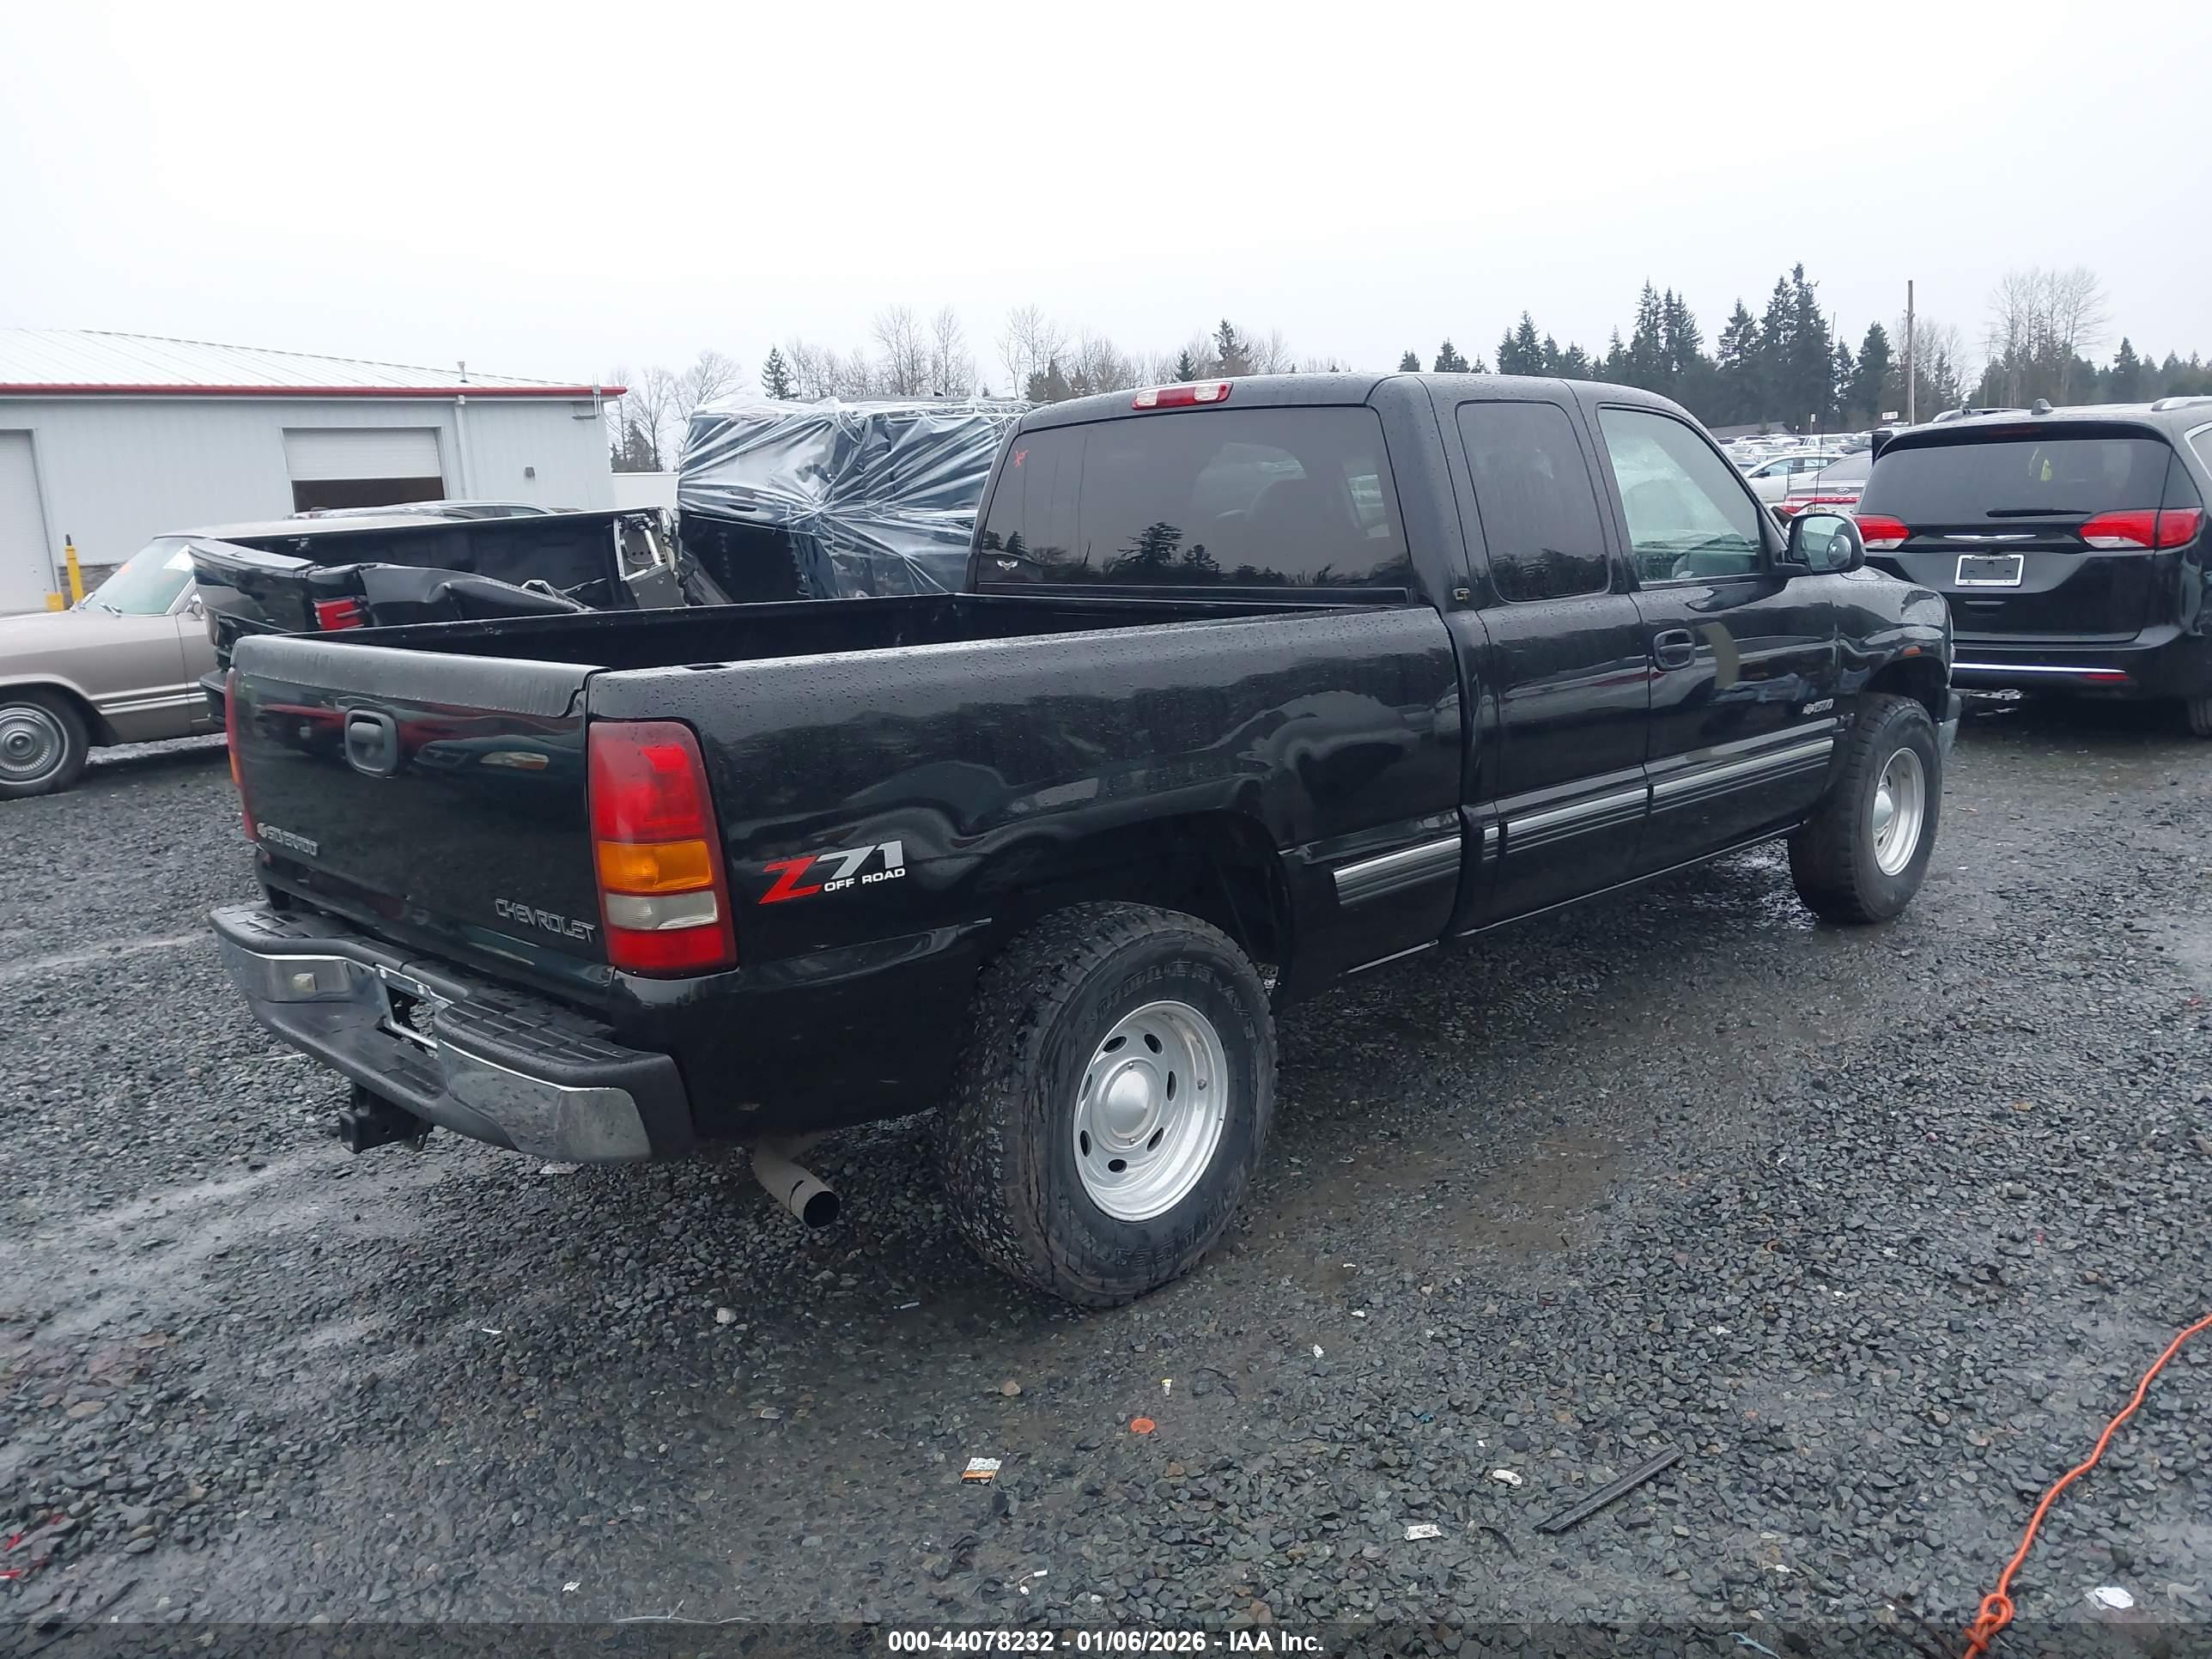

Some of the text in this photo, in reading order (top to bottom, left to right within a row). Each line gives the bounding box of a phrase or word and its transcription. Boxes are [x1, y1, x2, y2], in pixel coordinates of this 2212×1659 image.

[757, 840, 904, 905] Z71
[823, 867, 906, 892] OFF ROAD
[495, 897, 596, 943] CHEVROLET
